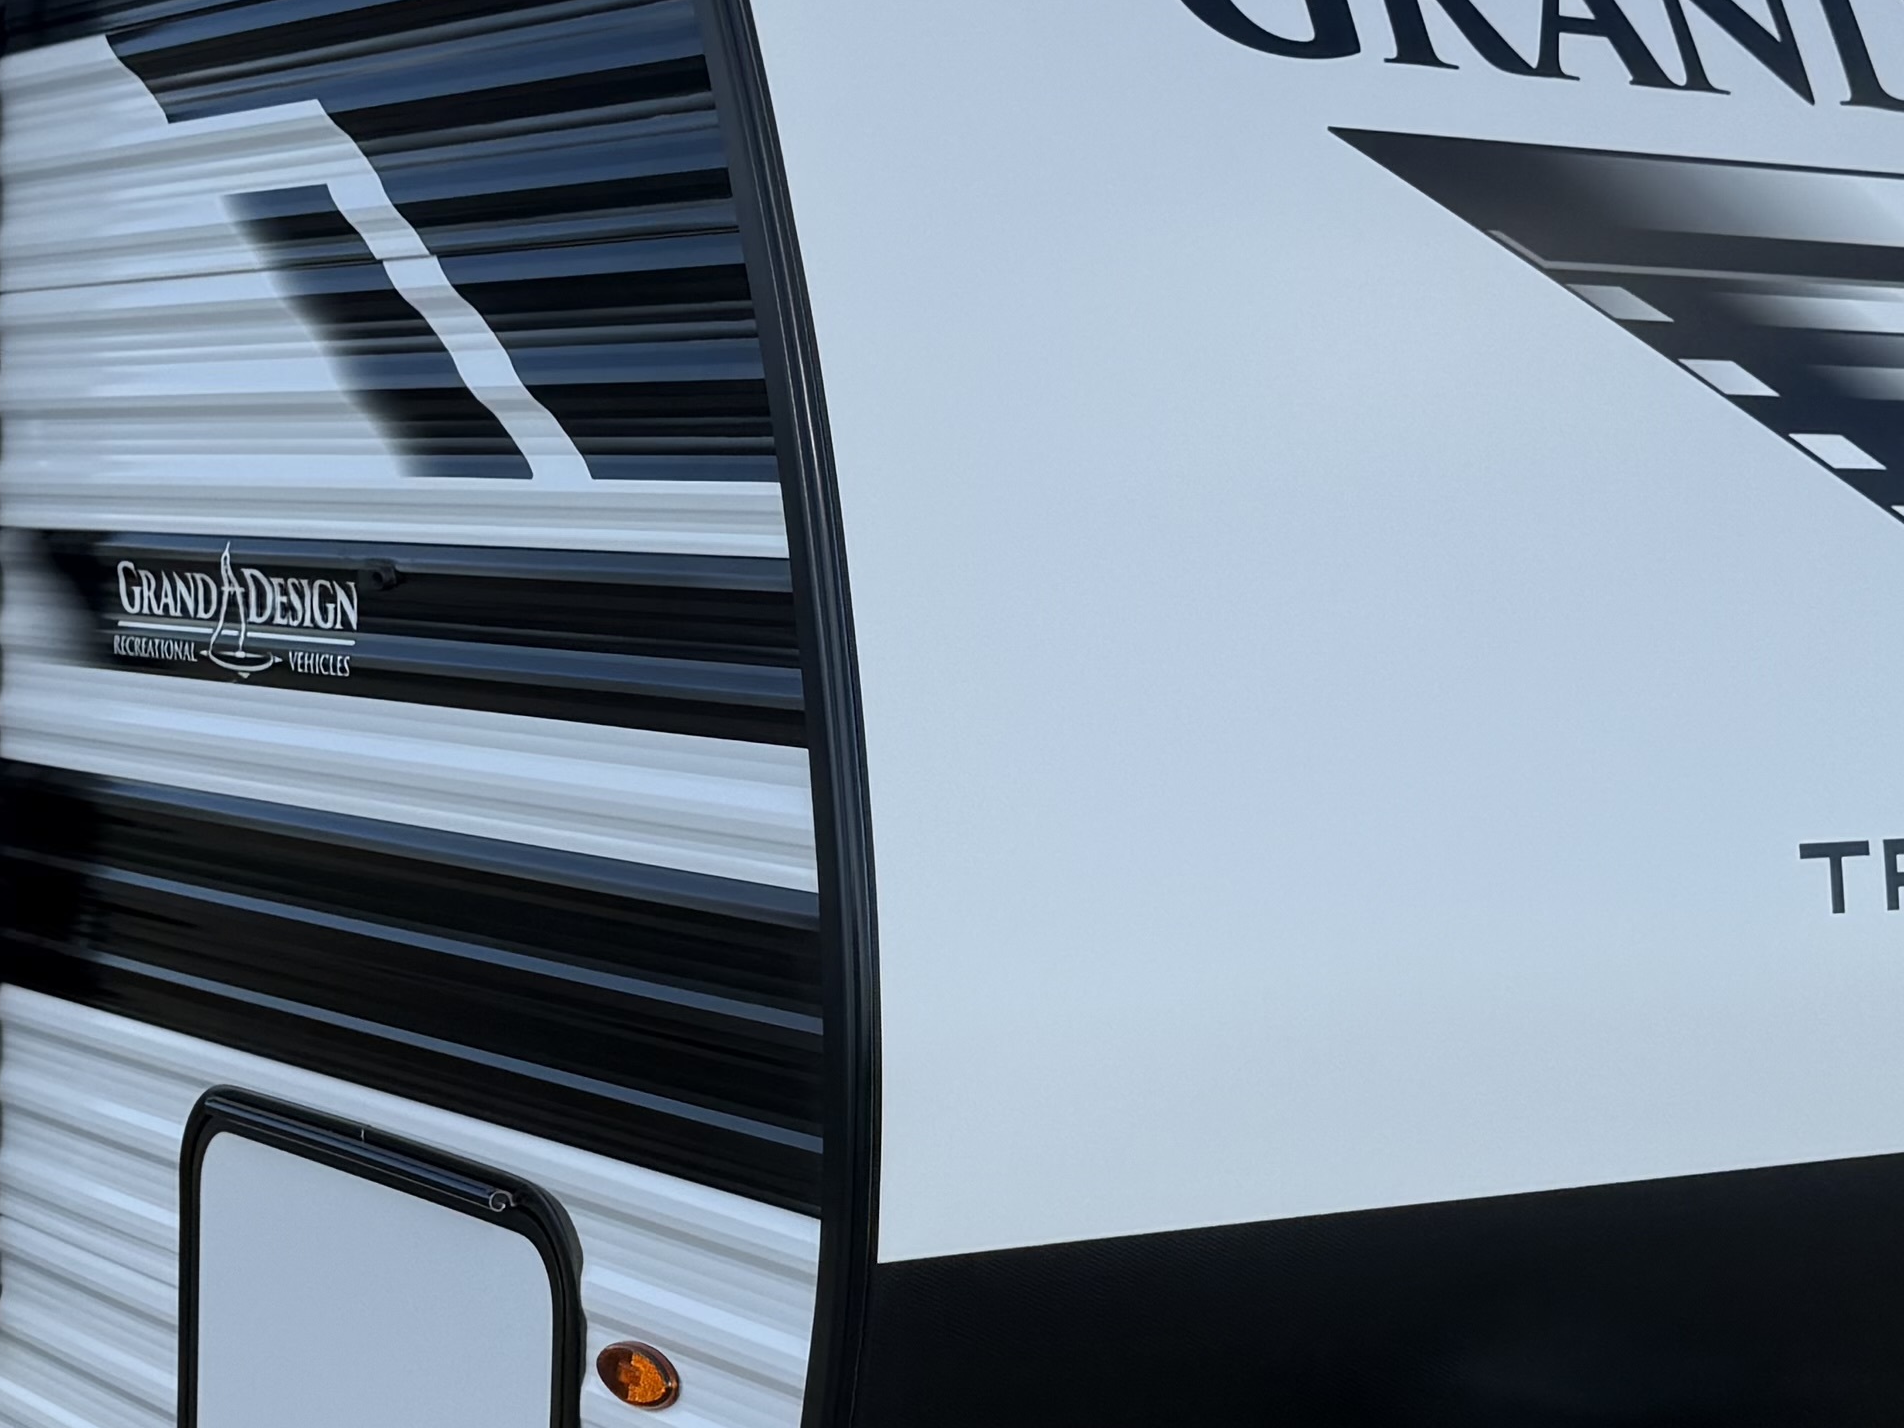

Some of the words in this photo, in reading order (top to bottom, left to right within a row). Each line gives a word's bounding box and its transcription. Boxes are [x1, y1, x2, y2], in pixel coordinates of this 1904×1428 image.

[116, 560, 218, 620] GRAND
[240, 568, 358, 631] DESIGN
[113, 634, 198, 662] RECREATIONAL
[288, 650, 350, 678] VEHICLES
